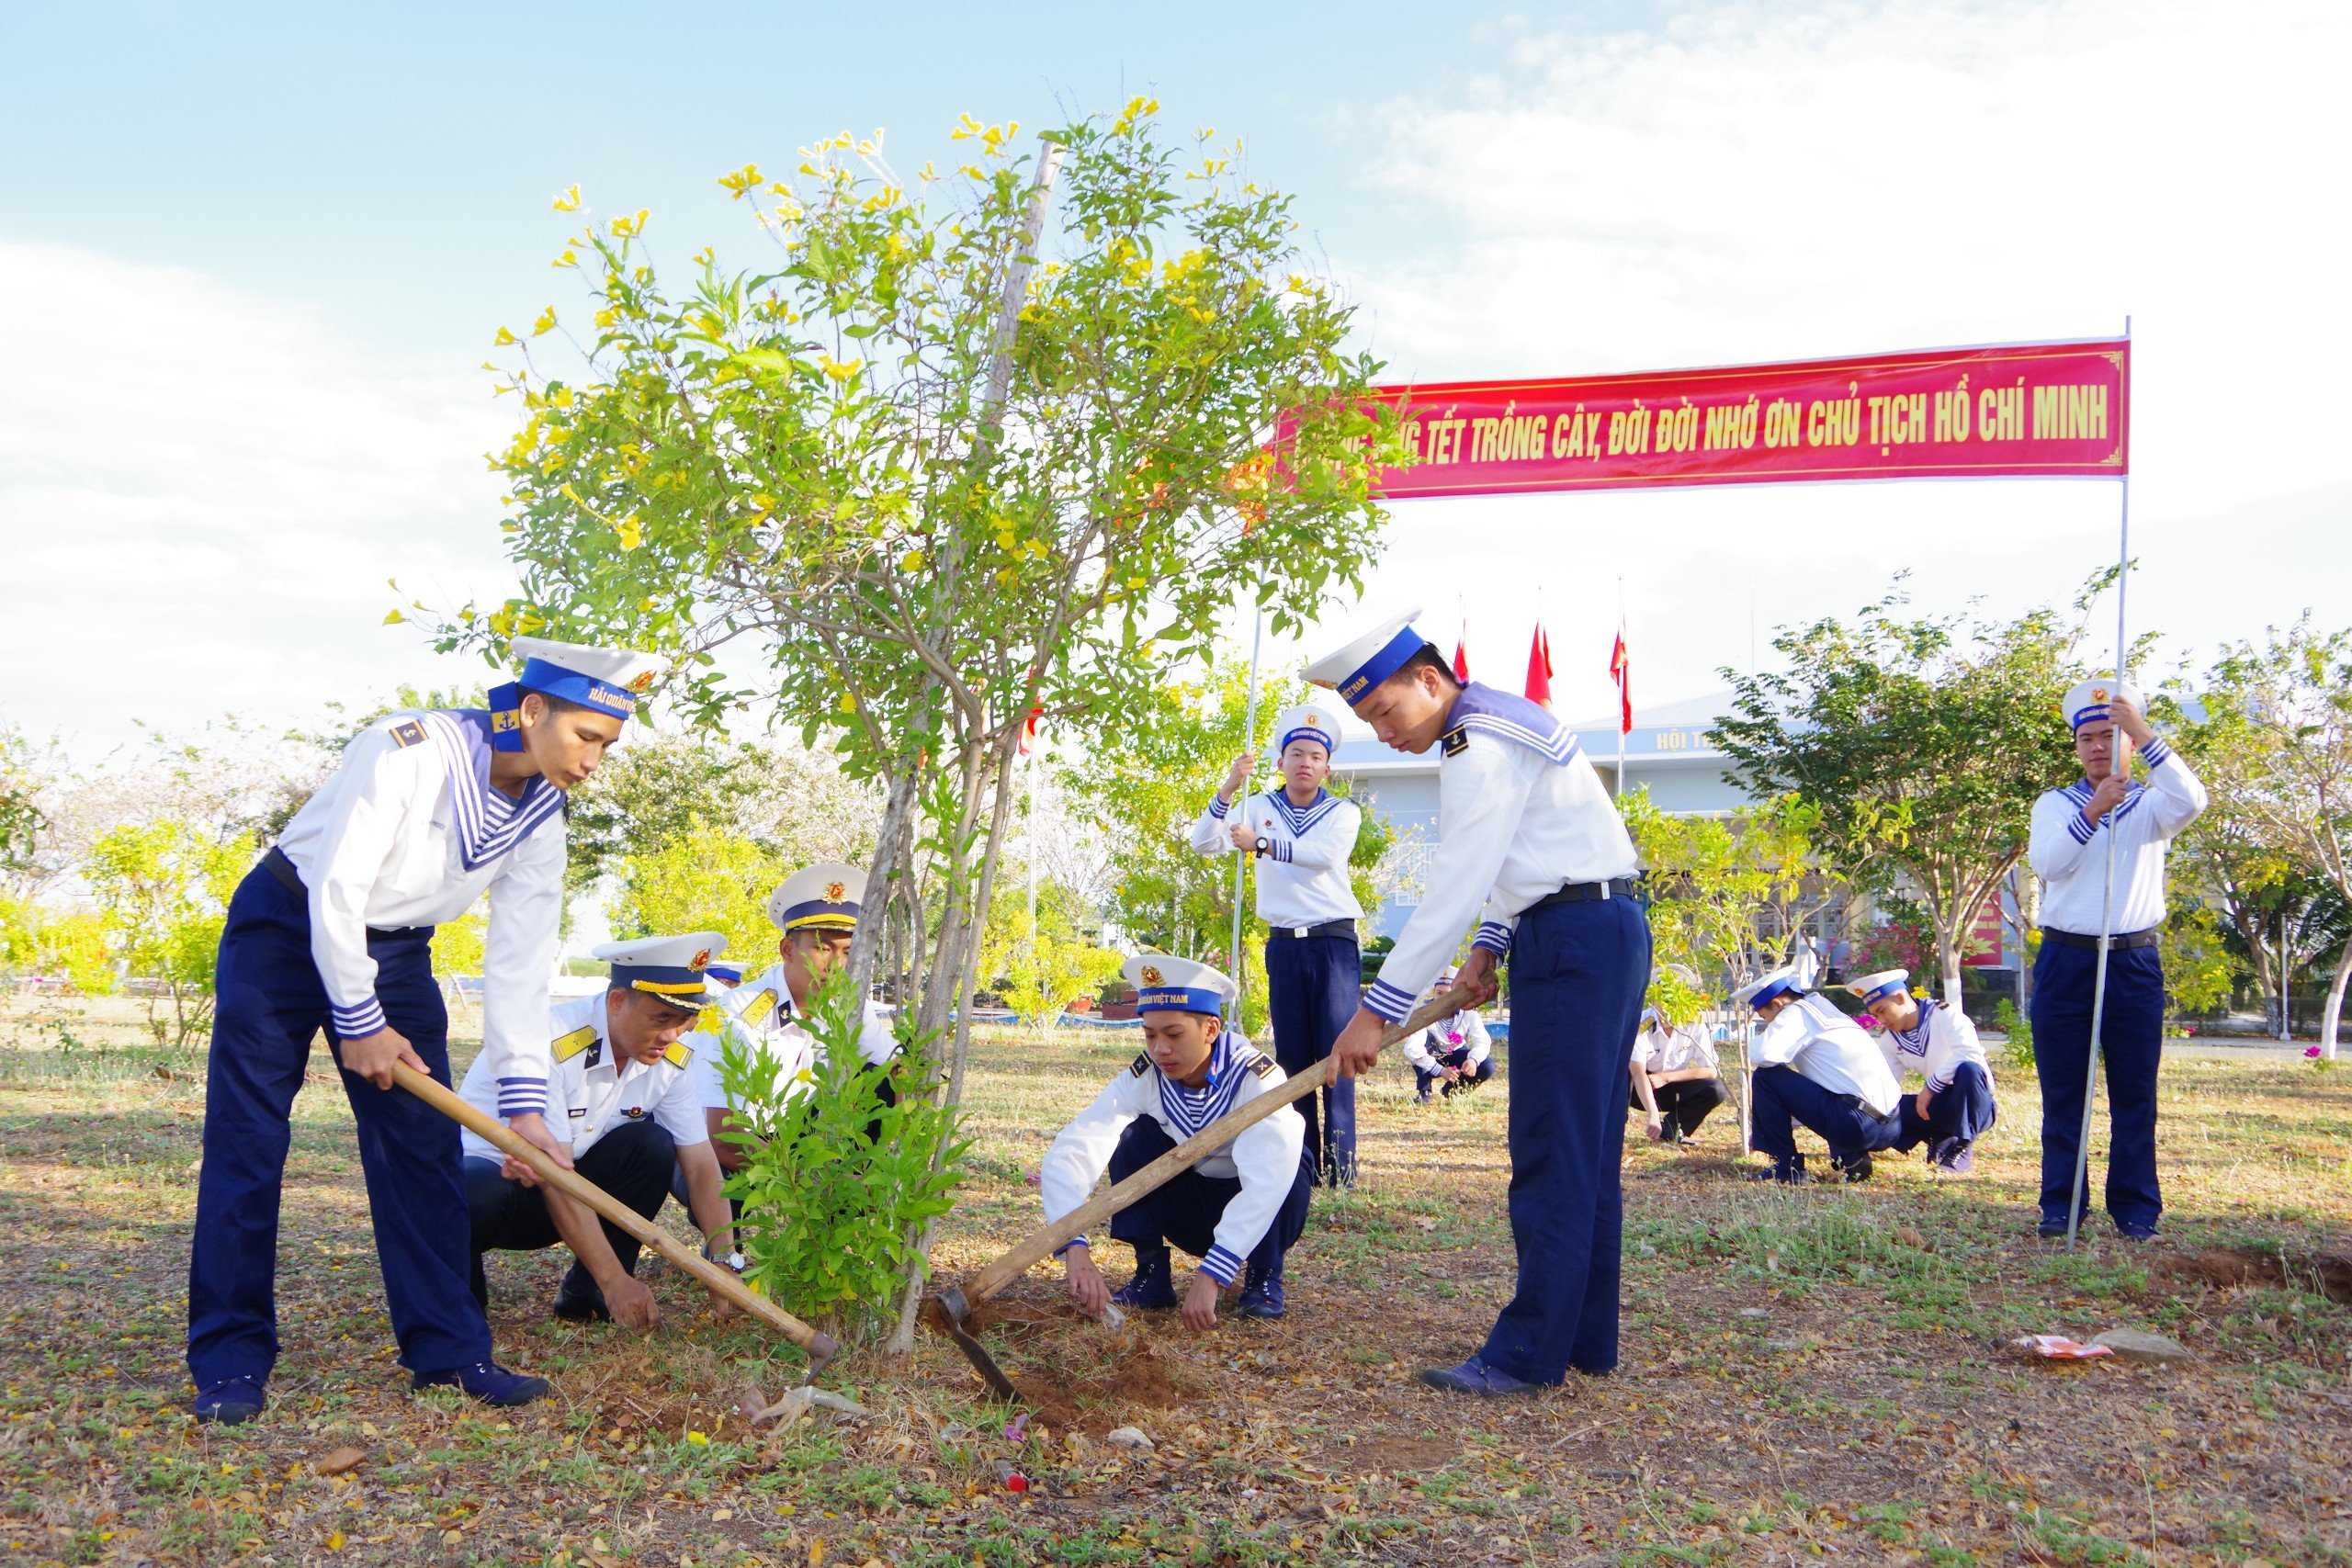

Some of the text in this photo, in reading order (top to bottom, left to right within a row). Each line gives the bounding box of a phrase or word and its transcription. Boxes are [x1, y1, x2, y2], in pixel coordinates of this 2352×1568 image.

[1427, 403, 1467, 465] TẾT
[1469, 399, 1546, 463] TRỒNG
[1551, 402, 1601, 462] CÂY,
[1608, 398, 1650, 456] ĐỜI
[1655, 396, 1699, 454] ĐỜI
[1703, 393, 1759, 451] NHỚ
[1763, 397, 1801, 447] ƠN
[1807, 380, 1860, 447] CHỦ
[1868, 392, 1927, 457] TỊCH
[1934, 373, 1971, 443] HỒ
[1978, 376, 2026, 442] CHÍ
[2032, 384, 2109, 440] MINH
[1351, 675, 1369, 693] NAM
[589, 686, 607, 705] HẢI
[605, 694, 629, 712] QUÂN
[1657, 728, 1687, 752] HỘI
[1153, 992, 1170, 1005] VIỆT
[1170, 994, 1188, 1004] NAM
